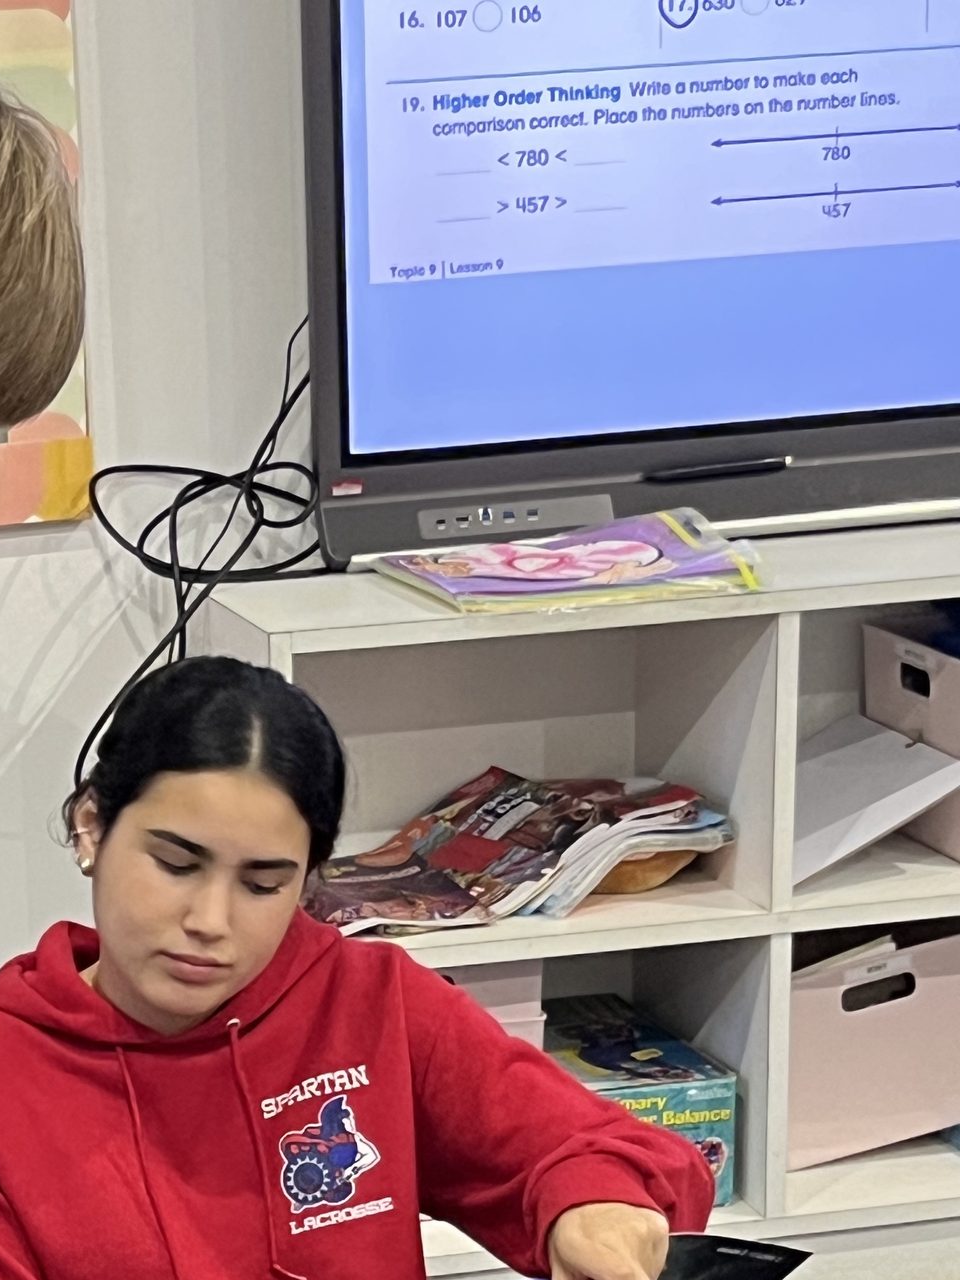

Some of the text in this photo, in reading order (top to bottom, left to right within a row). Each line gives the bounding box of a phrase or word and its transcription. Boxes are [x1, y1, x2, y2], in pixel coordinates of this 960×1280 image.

[399, 6, 541, 28] 16. 107 106
[402, 69, 858, 113] 19. Higher Order Thinking Write a number to make each
[432, 91, 901, 137] comparison correct. Place the numbers on the number lines.
[515, 149, 549, 168] 780
[821, 144, 851, 161] 780
[515, 195, 550, 213] 457
[822, 202, 851, 219] 457
[390, 265, 425, 279] Topic
[450, 261, 493, 275] Lesson
[261, 1065, 369, 1119] SPARTAN
[662, 1109, 732, 1126] Balance
[290, 1197, 394, 1235] LACROSSE
